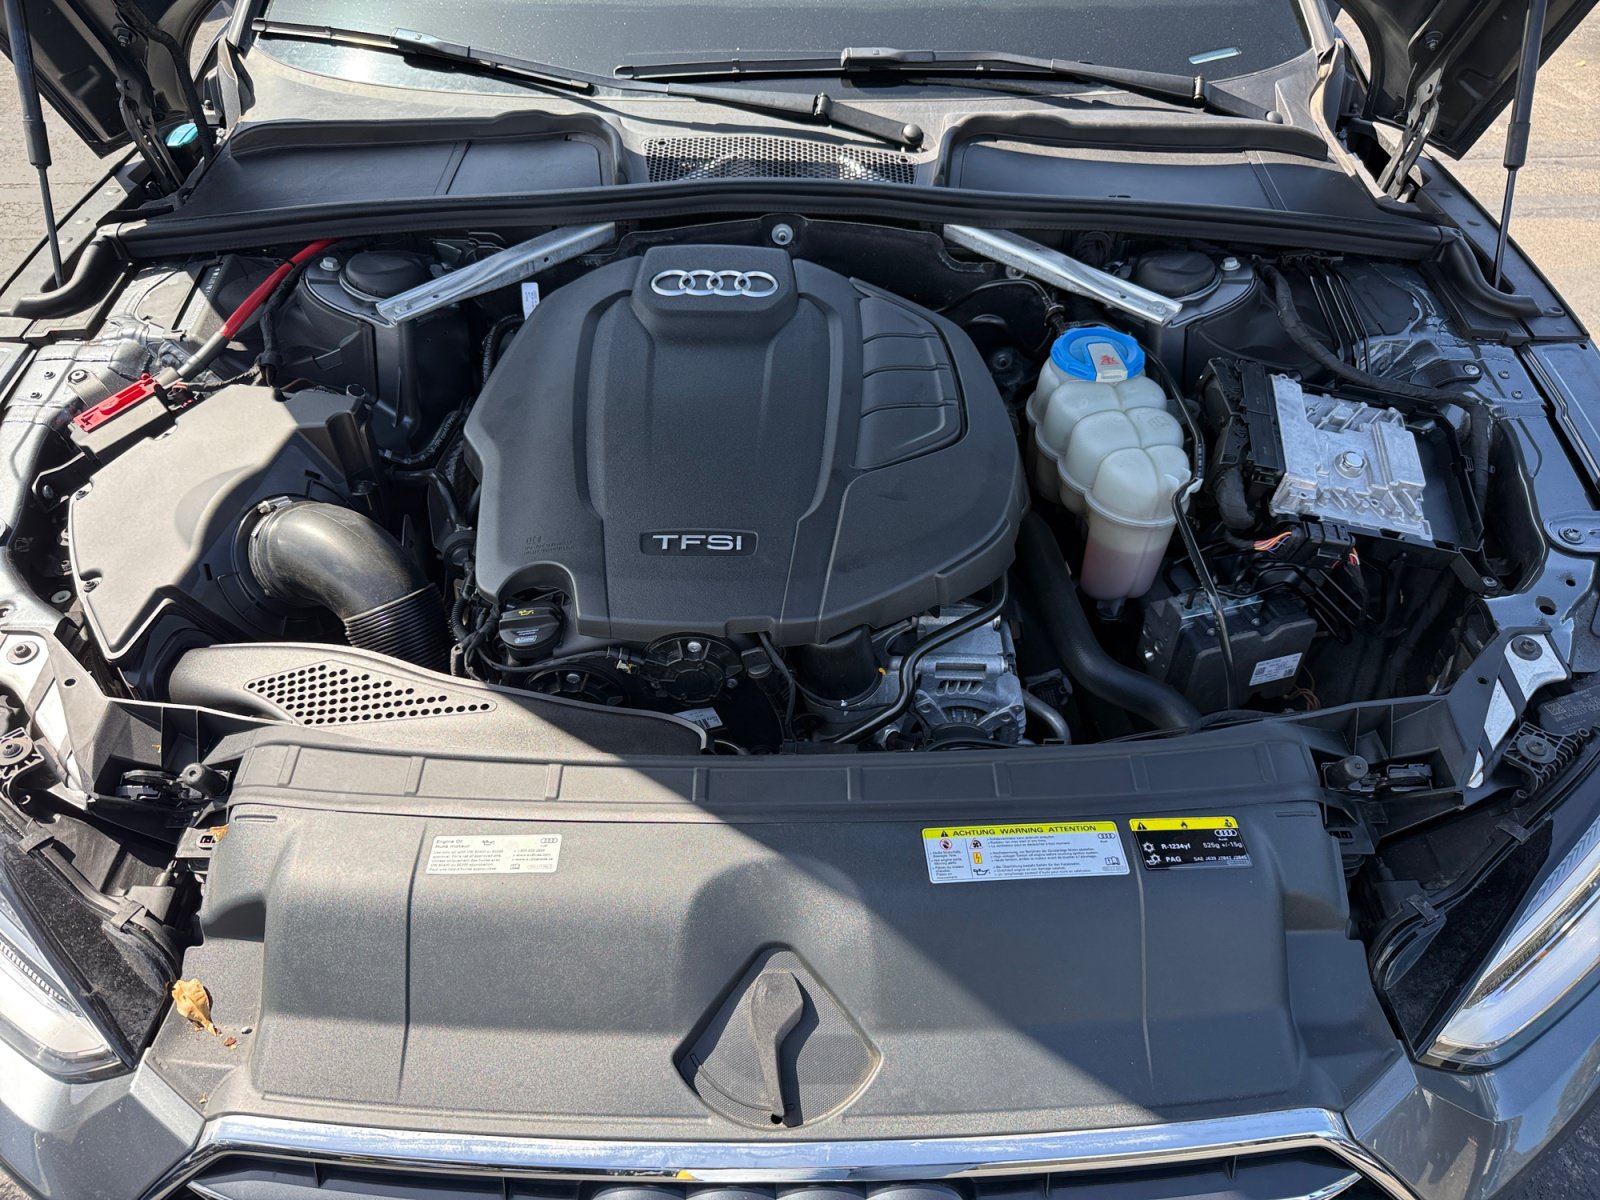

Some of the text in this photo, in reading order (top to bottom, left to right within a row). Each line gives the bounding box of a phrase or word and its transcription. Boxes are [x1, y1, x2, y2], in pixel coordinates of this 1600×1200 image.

[652, 534, 742, 551] TFSI
[952, 825, 1097, 837] ACHTUNG WARNING ATTENTION
[1160, 842, 1192, 851] R-1234yf
